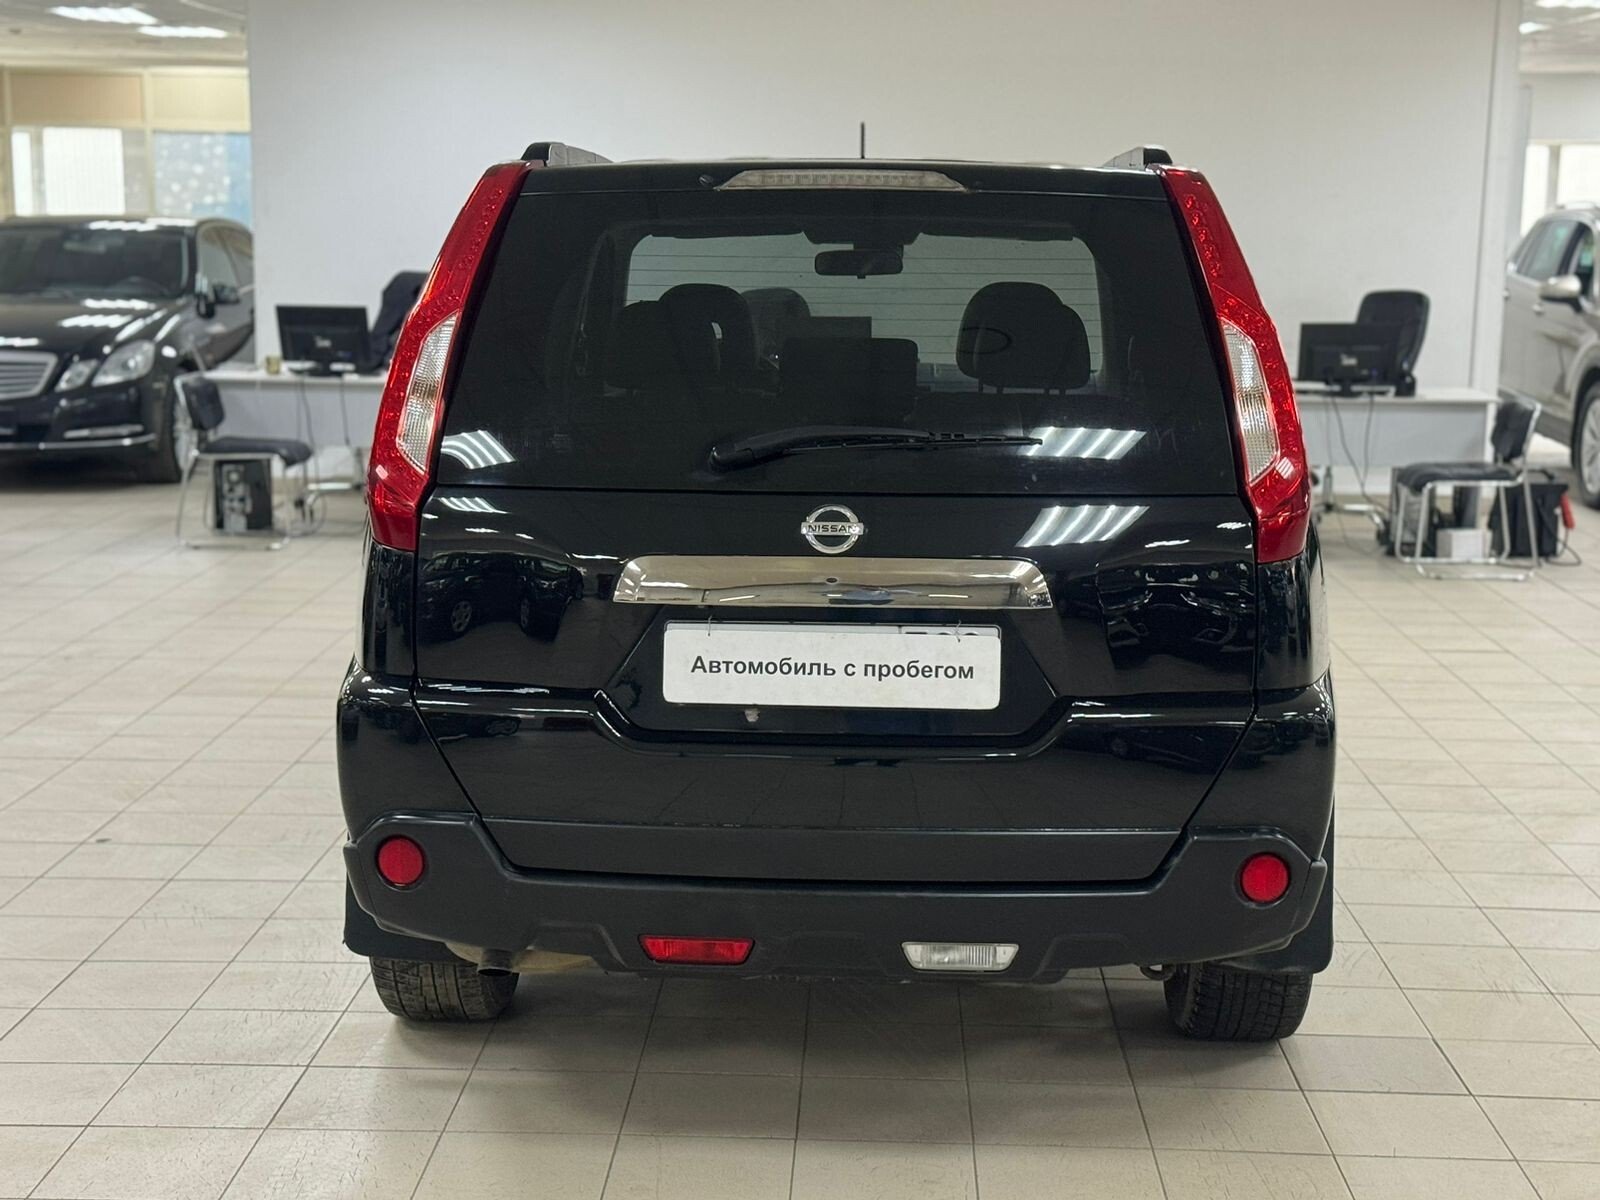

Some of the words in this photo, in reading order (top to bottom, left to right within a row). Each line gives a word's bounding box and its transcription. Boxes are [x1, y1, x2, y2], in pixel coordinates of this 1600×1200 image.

[690, 655, 837, 677] Автомобиль
[843, 663, 856, 677] с
[863, 660, 975, 682] пробегом
